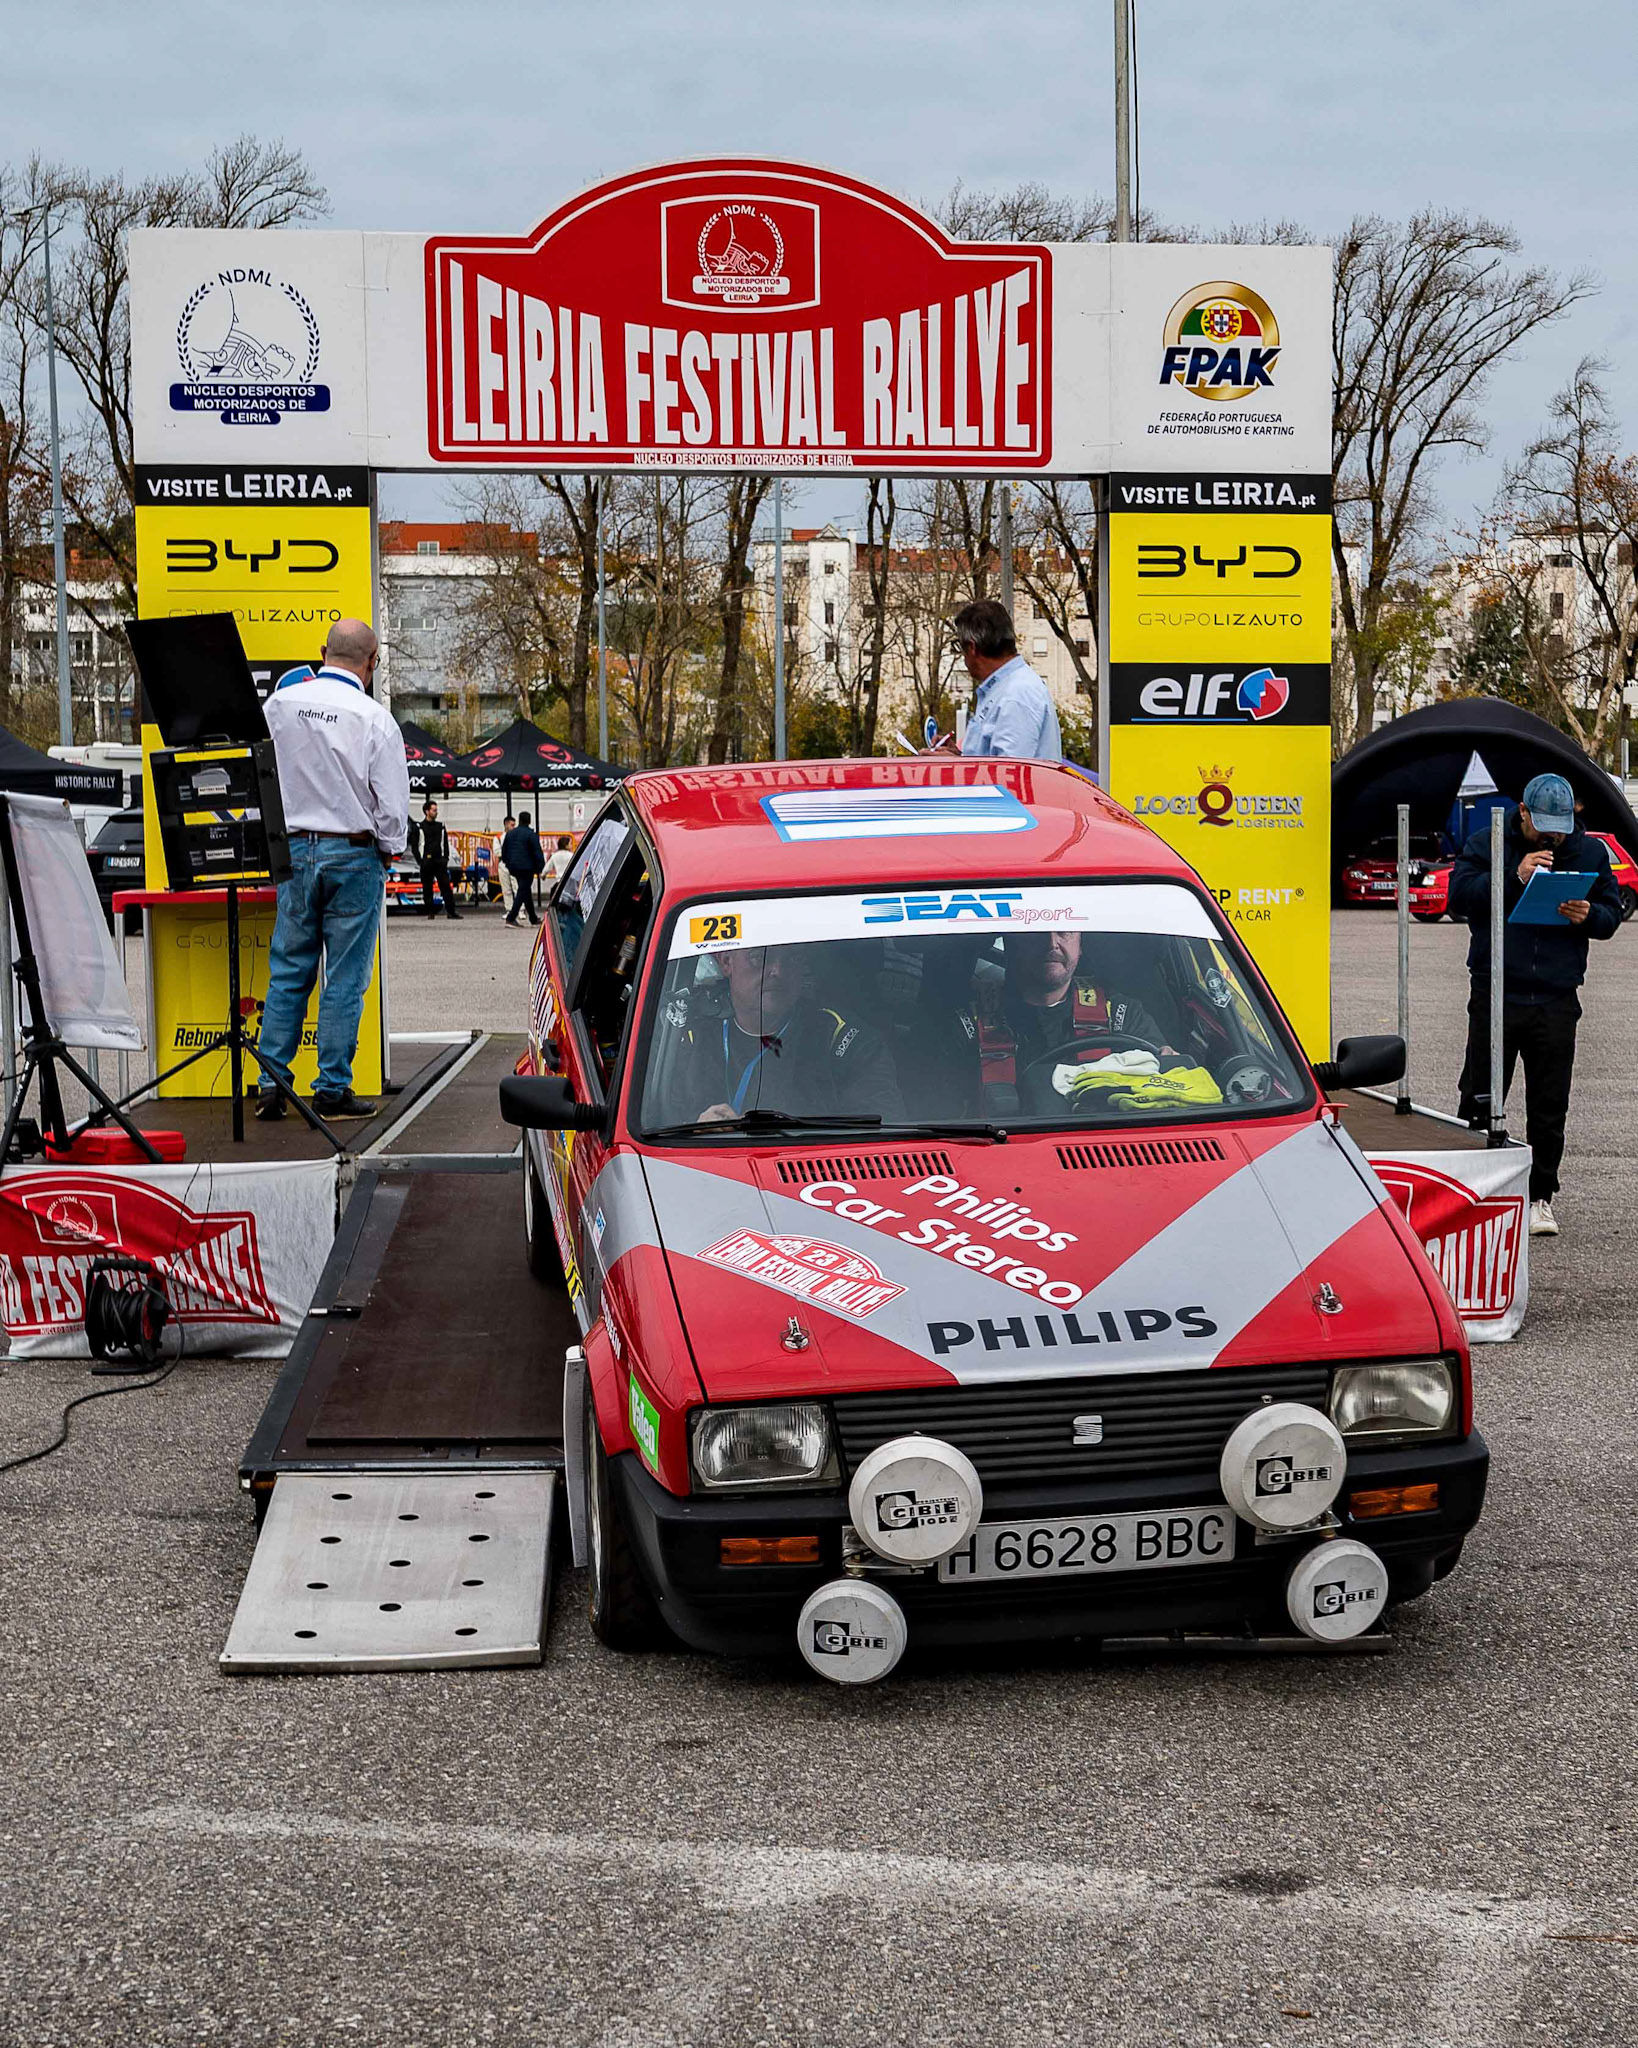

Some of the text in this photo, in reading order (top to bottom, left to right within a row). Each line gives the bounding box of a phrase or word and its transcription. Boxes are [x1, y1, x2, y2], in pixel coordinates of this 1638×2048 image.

[723, 205, 757, 217] NDML
[217, 268, 274, 288] NDML
[735, 277, 781, 285] DESPORTOS
[729, 294, 754, 302] LEIRIA
[765, 286, 775, 294] DE
[449, 257, 1031, 448] LEIRIA FESTIVAL RALLYE
[1159, 346, 1283, 386] FPAK
[238, 385, 317, 398] DESPORTOS
[194, 398, 307, 411] MOTORIZADOS DE
[230, 412, 271, 424] LEIRIA
[1159, 411, 1283, 425] FEDERAÇÃO PORTUGUESA
[1147, 424, 1295, 436] DE AUTOMOBILISMO E KARTING
[633, 453, 854, 467] NUCLEO DESPORTOS MOTORIZADOS DE LEIRIA
[147, 473, 353, 501] VISITE LEIRIA.pt
[1121, 481, 1316, 507] VISITE LEIRIA.pt
[166, 539, 340, 574] BYD
[1137, 545, 1302, 579] BYD
[1139, 673, 1235, 716] elf
[297, 707, 339, 724] ndml.pt
[55, 775, 116, 789] HISTORIC RALLY
[456, 776, 499, 789] 24MX
[538, 776, 582, 788] 24MX
[861, 893, 1089, 924] SEAT sport
[1234, 910, 1243, 921] A
[1246, 910, 1271, 921] CAR
[703, 916, 737, 941] 23
[901, 1175, 1079, 1253] Philips
[798, 1180, 1084, 1305] Car Stereo
[801, 1249, 841, 1267] 23
[706, 1232, 771, 1269] LEIRIA
[751, 1254, 831, 1293] FESTIVAL
[812, 1277, 900, 1315] RALLYE
[836, 1259, 873, 1281] 2025
[926, 1306, 1219, 1355] PHILIPS
[631, 1384, 655, 1456] Valeo
[949, 1514, 1225, 1575] H 6628 BBC
